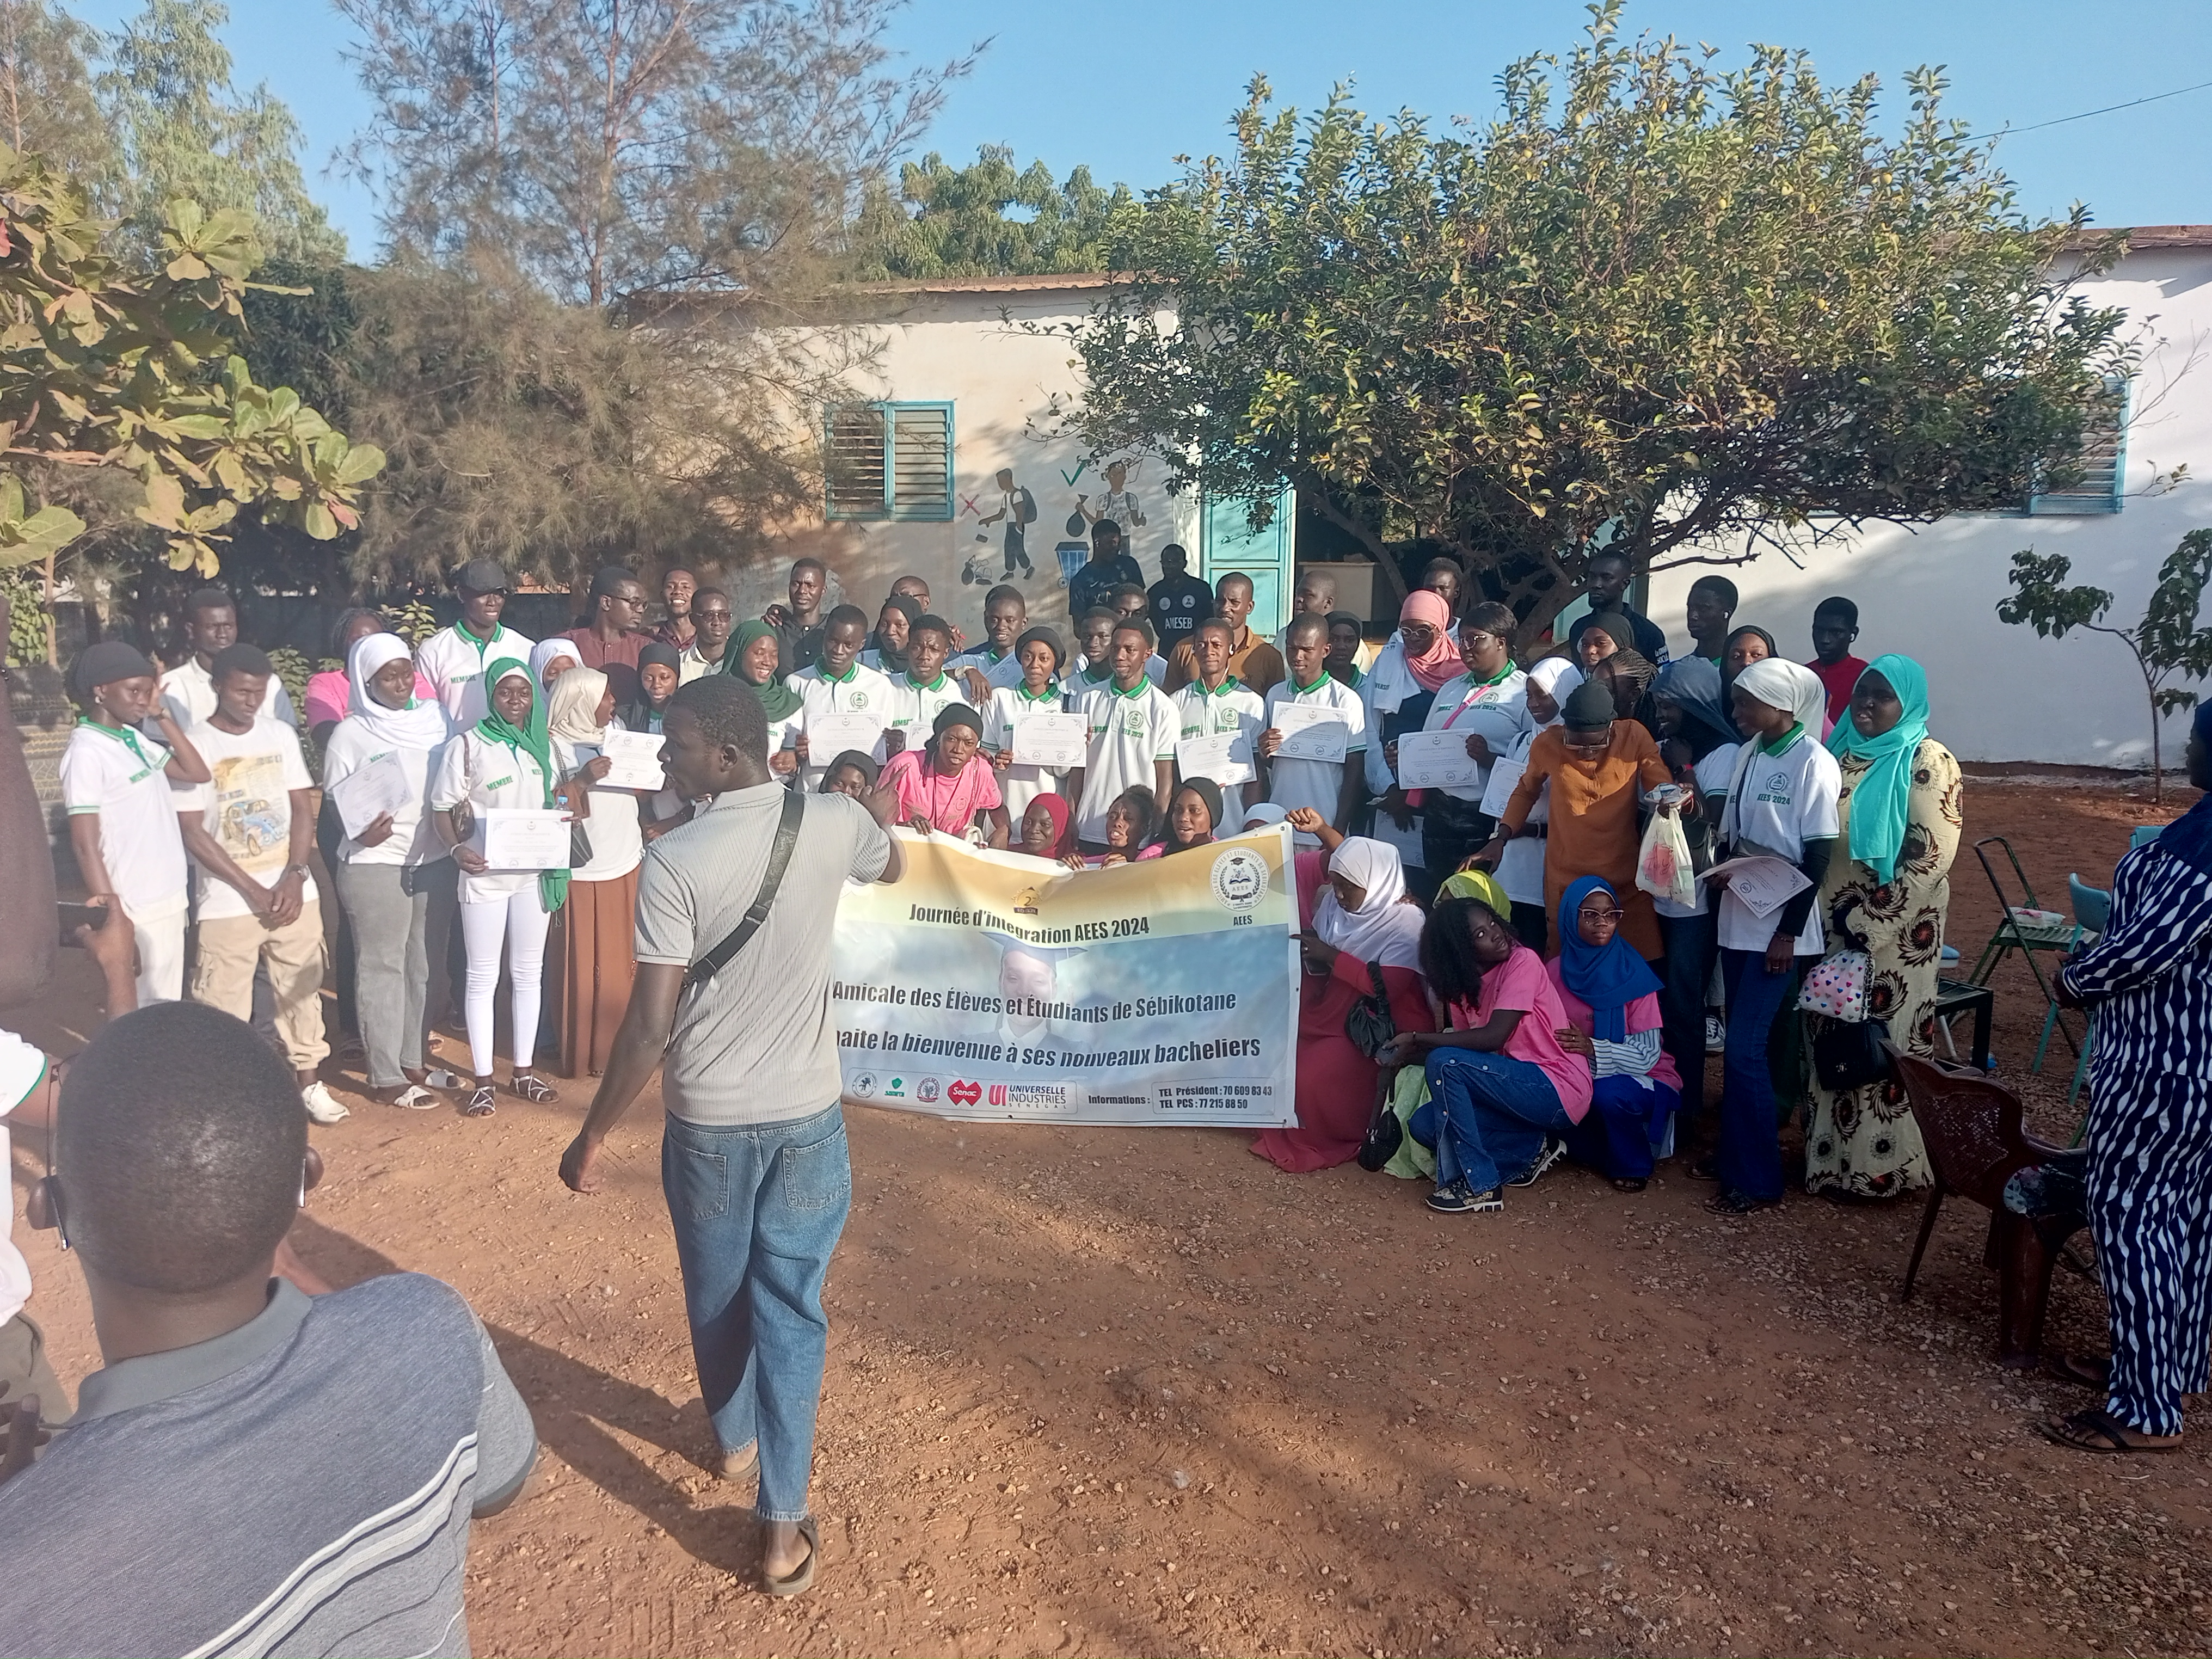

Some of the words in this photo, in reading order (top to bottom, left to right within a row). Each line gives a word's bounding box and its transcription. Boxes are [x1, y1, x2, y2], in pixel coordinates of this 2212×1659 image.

[1165, 617, 1193, 629] AMESEB
[486, 775, 513, 791] MEMBRE
[1773, 795, 1790, 805] 2024
[909, 904, 969, 925] Journée
[1074, 921, 1109, 942] AEES
[1111, 917, 1150, 938] 2024
[1233, 915, 1252, 926] AEES
[833, 981, 906, 1005] Amicale
[910, 988, 942, 1008] des
[946, 987, 1001, 1014] Élèves
[1006, 998, 1023, 1016] et
[1027, 994, 1108, 1023] Étudiants
[1113, 1001, 1132, 1021] de
[1136, 993, 1237, 1017] Sébikotane
[882, 1031, 899, 1051] la
[901, 1033, 1002, 1061] bienvenue
[1006, 1042, 1018, 1063] à
[1022, 1048, 1056, 1066] ses
[1060, 1048, 1151, 1067] nouveaux
[1154, 1038, 1261, 1064] bacheliers
[953, 1086, 978, 1097] Senac
[1009, 1085, 1066, 1095] UNIVERSELLE
[1158, 1089, 1172, 1097] TEL
[1223, 1085, 1233, 1095] 70
[1234, 1085, 1250, 1096] 609
[1251, 1086, 1261, 1096] 83
[1263, 1086, 1272, 1096] 43
[1009, 1093, 1066, 1104] INDUSTRIES
[1159, 1099, 1173, 1109] TEL
[1199, 1098, 1208, 1108] 77
[1209, 1098, 1224, 1108] 215
[1225, 1098, 1236, 1109] 88
[1237, 1099, 1248, 1109] 50
